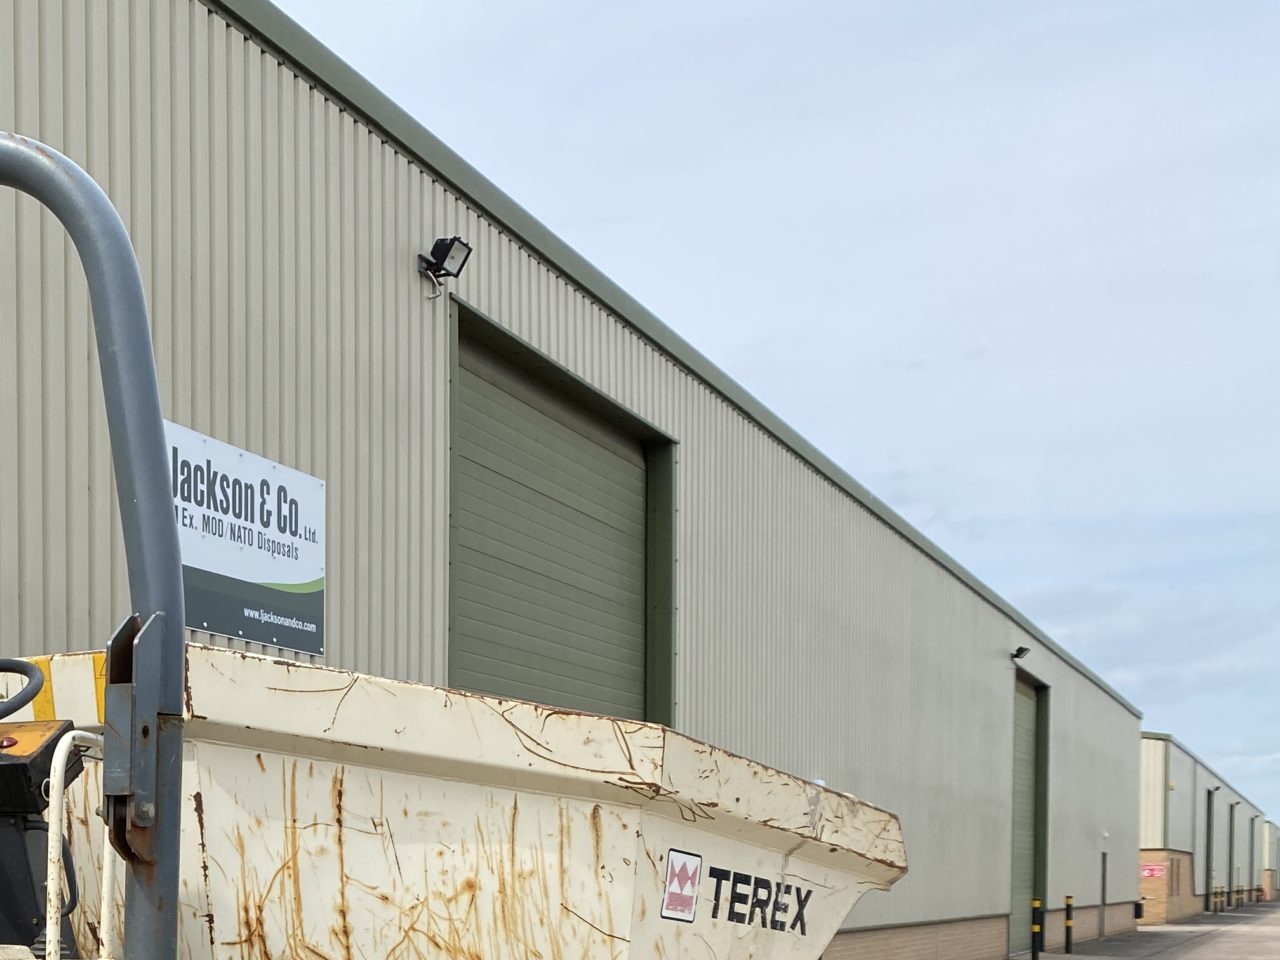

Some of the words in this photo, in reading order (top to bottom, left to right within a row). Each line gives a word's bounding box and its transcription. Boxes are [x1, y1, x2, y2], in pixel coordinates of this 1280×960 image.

[171, 446, 255, 524] Jackson
[259, 479, 272, 529] &
[277, 485, 302, 539] Co.
[304, 526, 318, 544] Ltd.
[182, 507, 197, 530] Ex.
[202, 513, 254, 547] MOD/NATO
[257, 531, 299, 561] Disposals
[708, 866, 813, 936] TEREX
